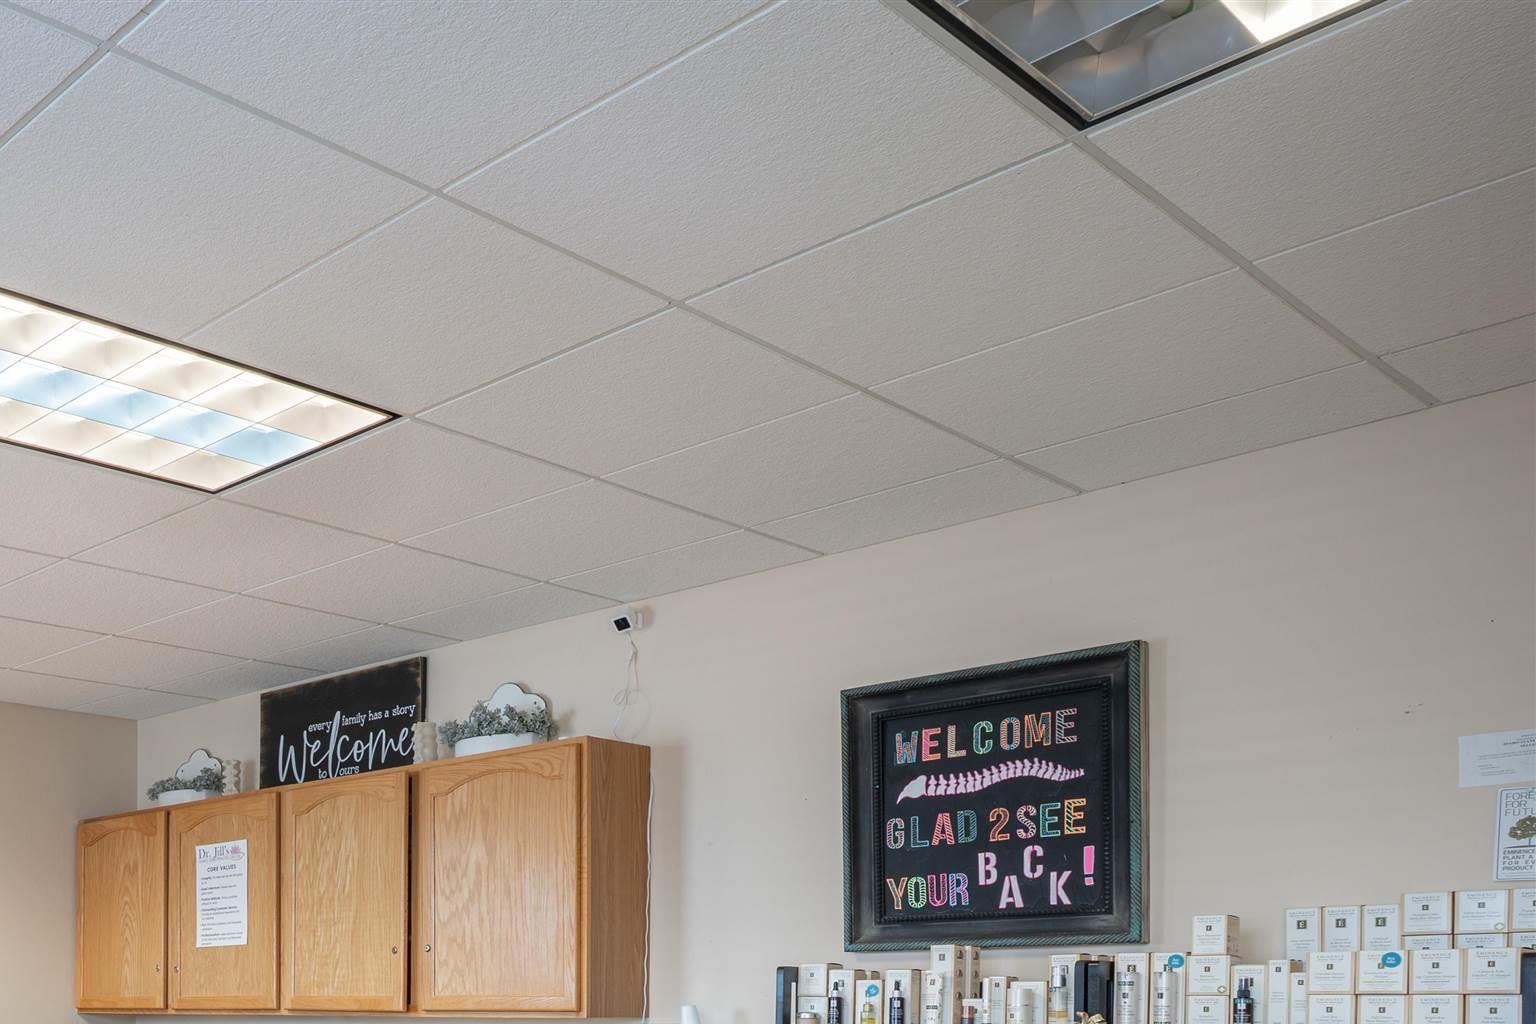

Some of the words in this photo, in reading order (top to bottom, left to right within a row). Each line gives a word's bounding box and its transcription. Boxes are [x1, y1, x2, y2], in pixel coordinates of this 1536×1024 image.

[308, 720, 332, 733] every
[342, 713, 366, 727] family
[368, 710, 382, 721] has
[392, 705, 416, 718] story
[895, 708, 1077, 764] WELCOME
[278, 710, 415, 783] Welcome
[318, 769, 327, 779] to
[339, 766, 359, 776] ours
[886, 810, 977, 849] GLAD
[199, 849, 209, 858] Dr.
[214, 845, 229, 858] Jill's
[886, 872, 969, 910] YOUR
